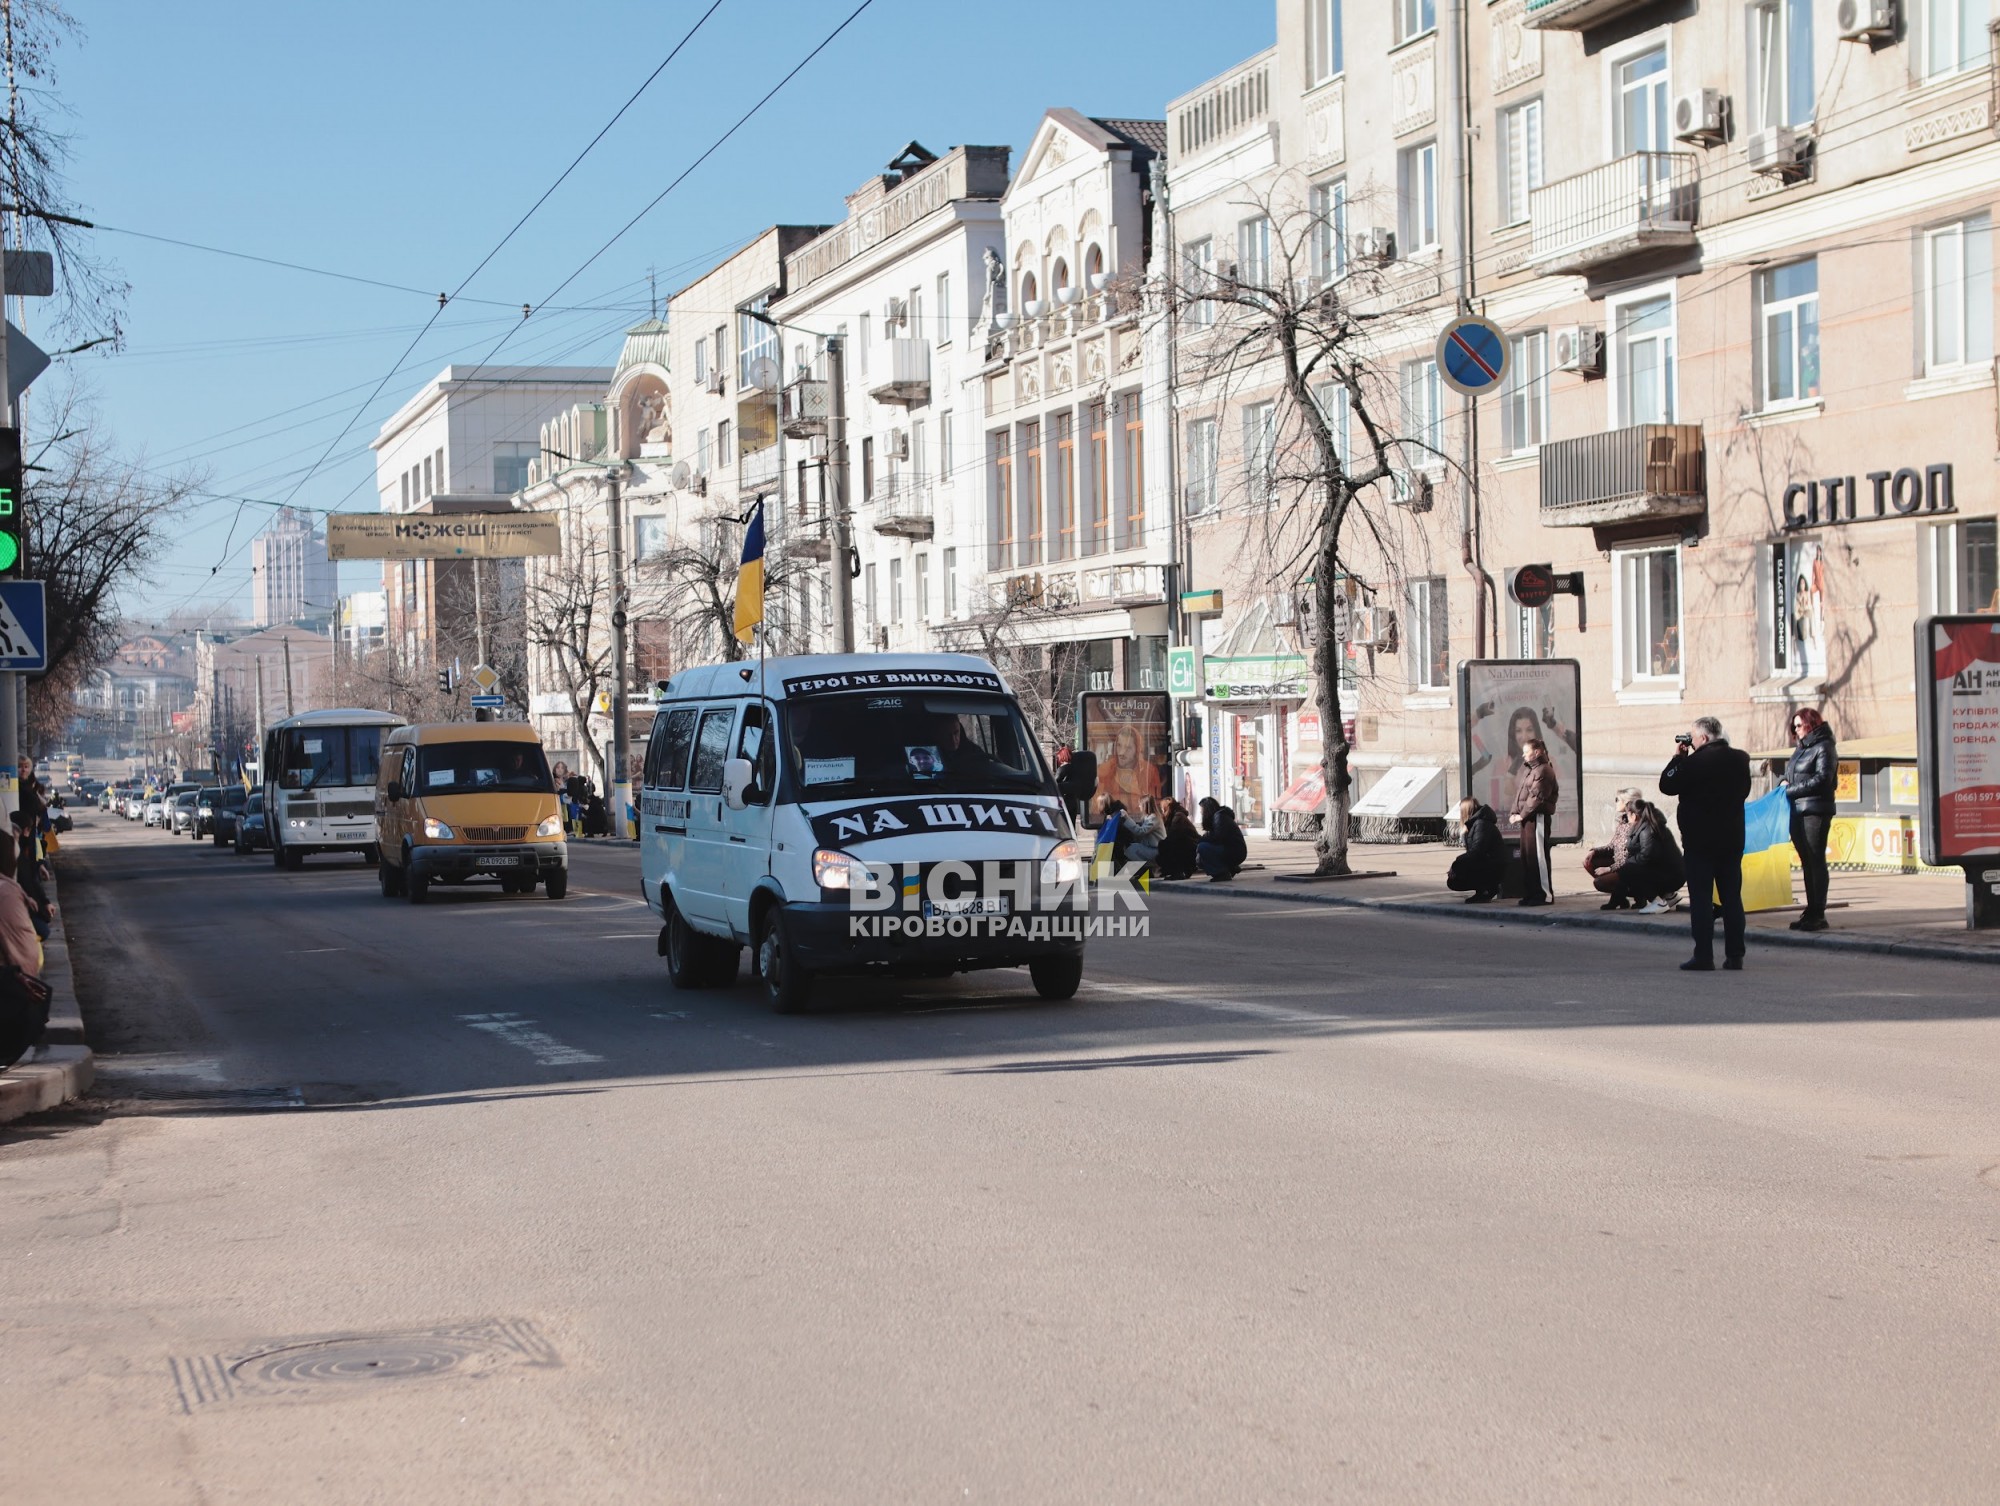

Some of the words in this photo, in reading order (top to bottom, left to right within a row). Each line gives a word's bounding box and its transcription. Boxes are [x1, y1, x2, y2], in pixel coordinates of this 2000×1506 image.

[1783, 475, 1856, 526] СІТІ
[1866, 463, 1953, 515] ТОП
[1776, 558, 1784, 604] ВЗУТТЯ
[1777, 606, 1785, 654] ЖІНОЧЕ
[1488, 669, 1551, 679] NaManicure
[886, 673, 999, 687] ВМИРАЮТЬ
[1230, 684, 1298, 696] SERVICE
[1101, 699, 1151, 710] TrueMan
[1953, 707, 1998, 716] КУПІВЛЯ
[1953, 721, 1999, 730] ПРОДАЖ
[1953, 736, 1996, 744] ОРЕНДА
[1954, 792, 1977, 803] (066)
[1979, 792, 1994, 801] 597
[918, 803, 1058, 832] ЩИТІ
[480, 857, 490, 865] BA
